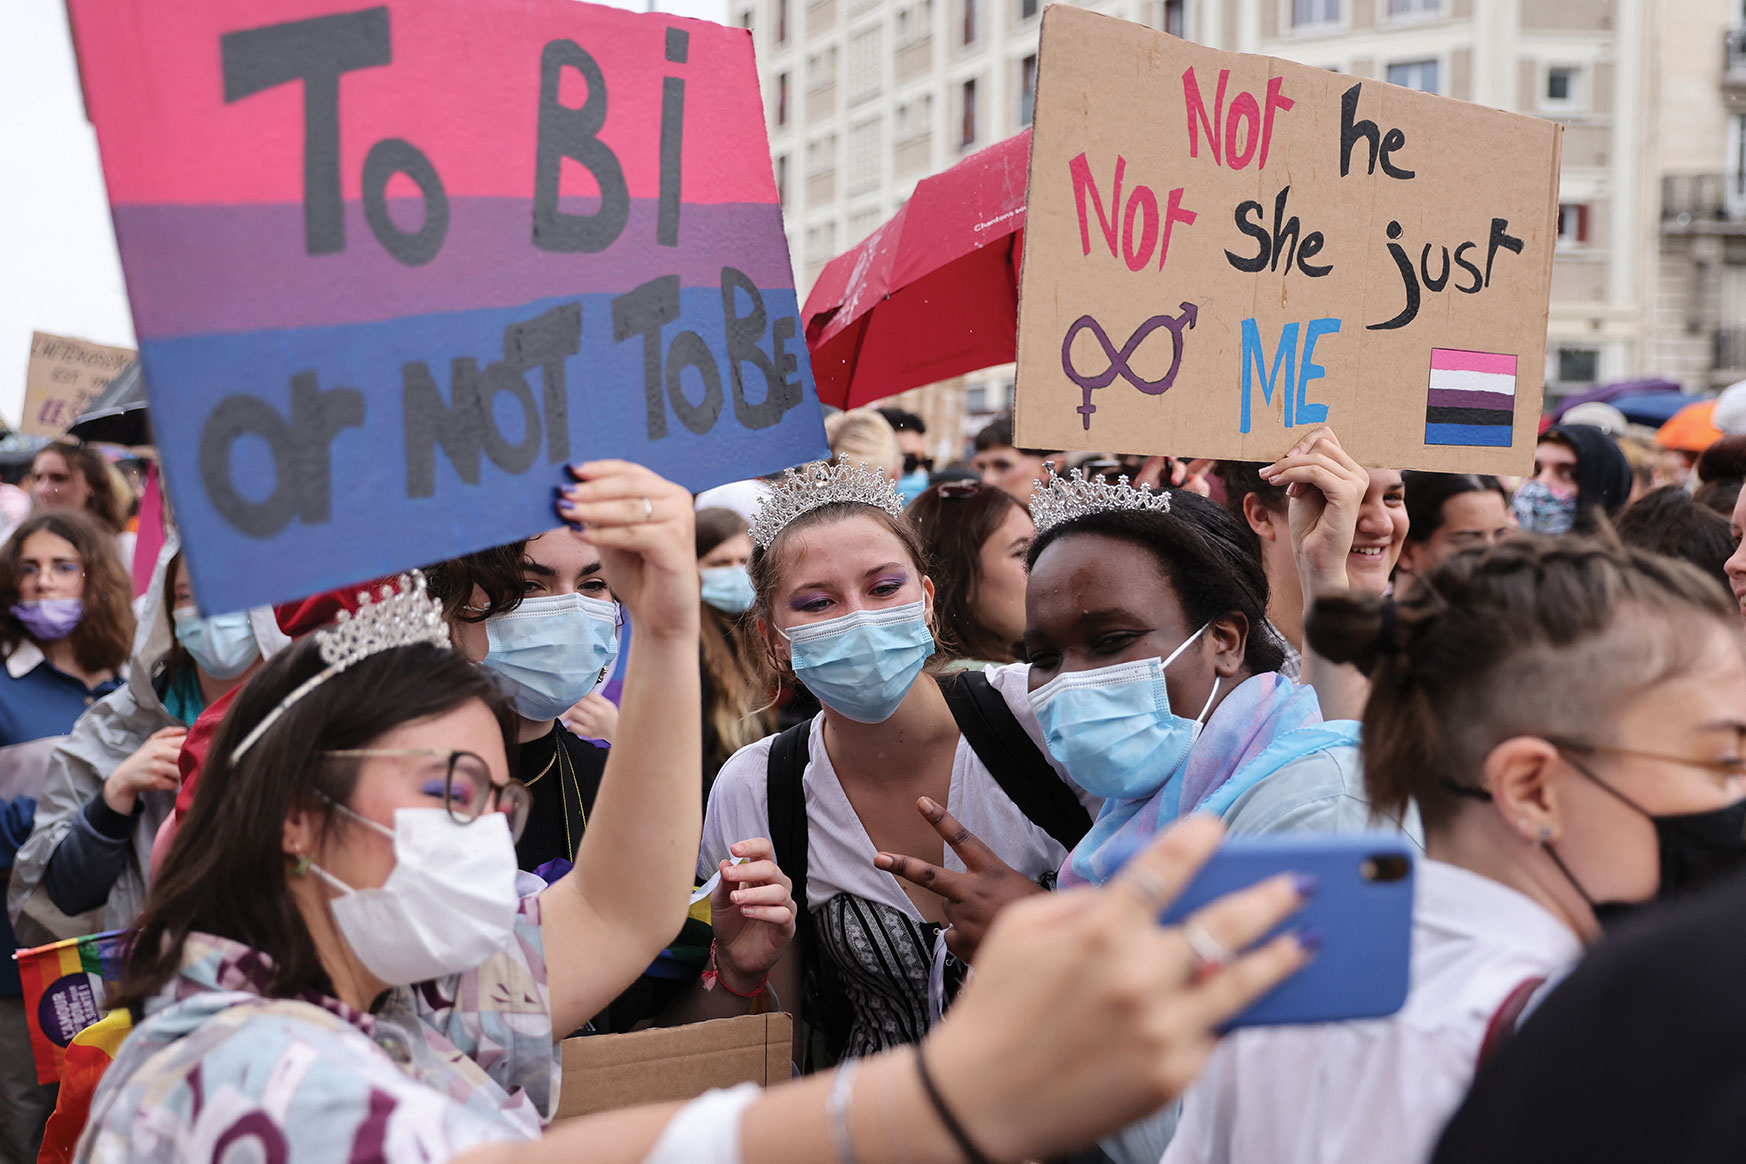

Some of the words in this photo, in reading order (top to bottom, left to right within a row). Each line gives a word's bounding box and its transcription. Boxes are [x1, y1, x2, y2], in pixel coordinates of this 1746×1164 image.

[531, 26, 689, 255] Bi
[1340, 82, 1415, 179] he
[1365, 218, 1523, 330] just
[201, 369, 367, 539] or
[404, 302, 582, 498] NOT
[720, 266, 802, 431] BE
[1240, 317, 1341, 433] ME
